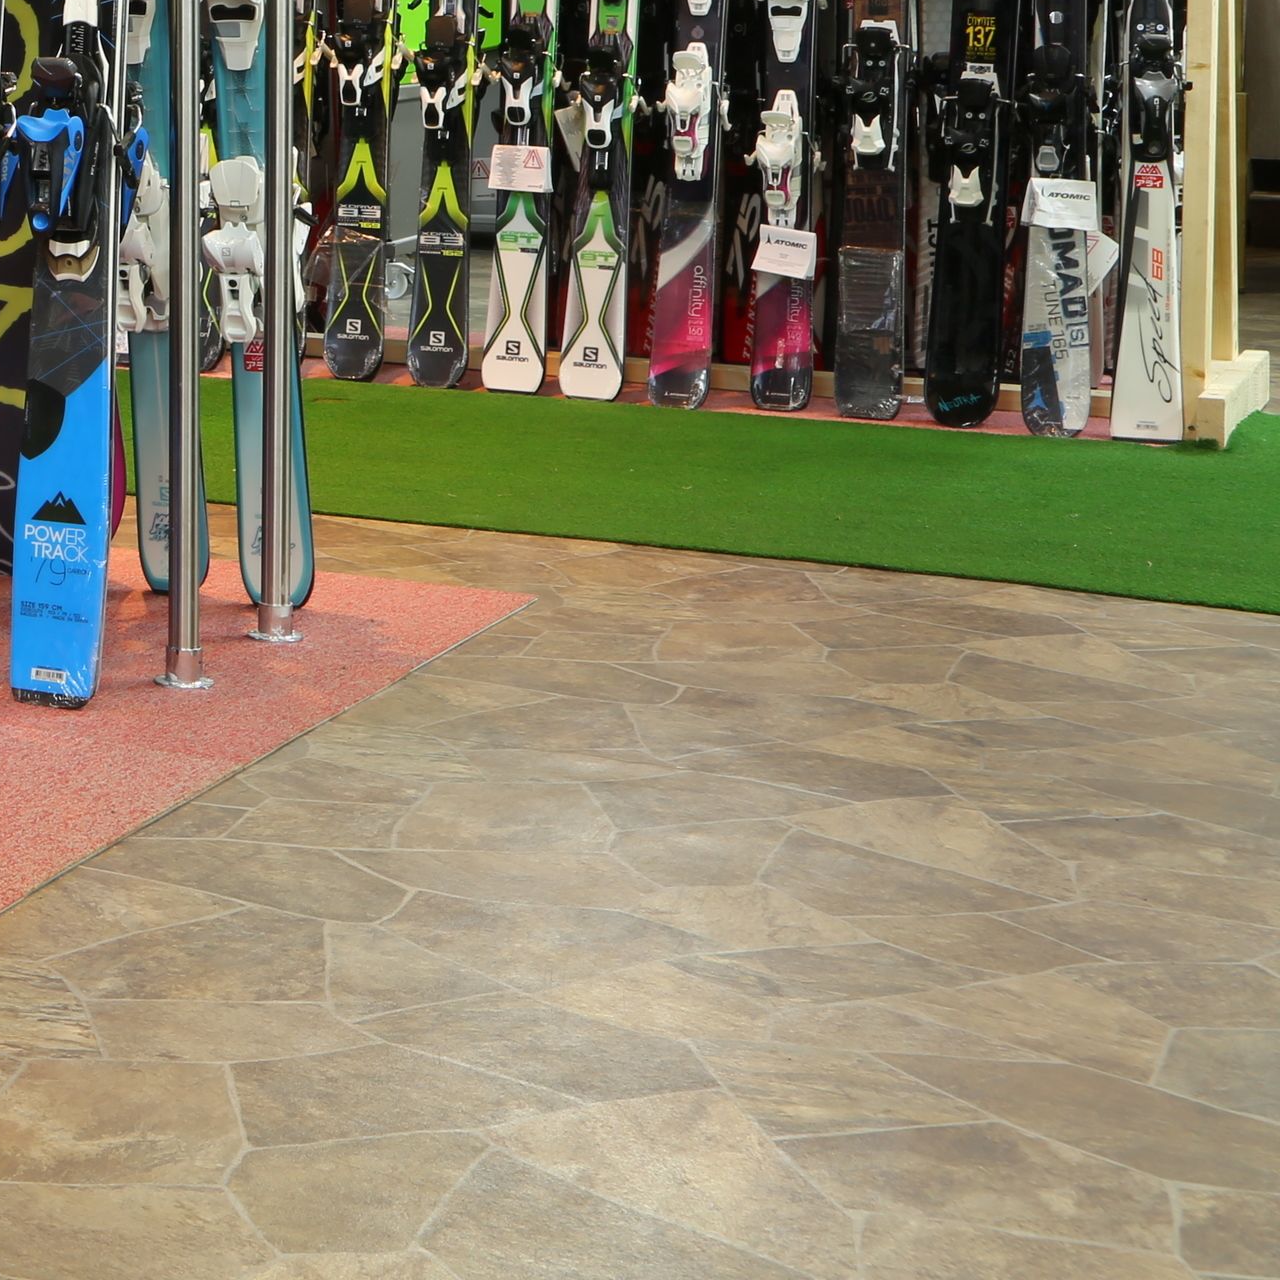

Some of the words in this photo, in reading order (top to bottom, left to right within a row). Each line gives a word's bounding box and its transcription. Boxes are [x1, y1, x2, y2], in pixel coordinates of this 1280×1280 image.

[966, 26, 995, 48] 137
[1136, 179, 1163, 188] アライ
[1047, 191, 1090, 201] ATOMIC
[773, 238, 808, 250] ATOMIC
[1048, 227, 1089, 320] OMAD
[693, 265, 709, 318] affinity
[337, 333, 369, 341] salomon
[496, 354, 529, 363] salomon
[573, 361, 607, 369] salomon
[24, 524, 87, 546] POWER
[32, 542, 89, 563] TRACK
